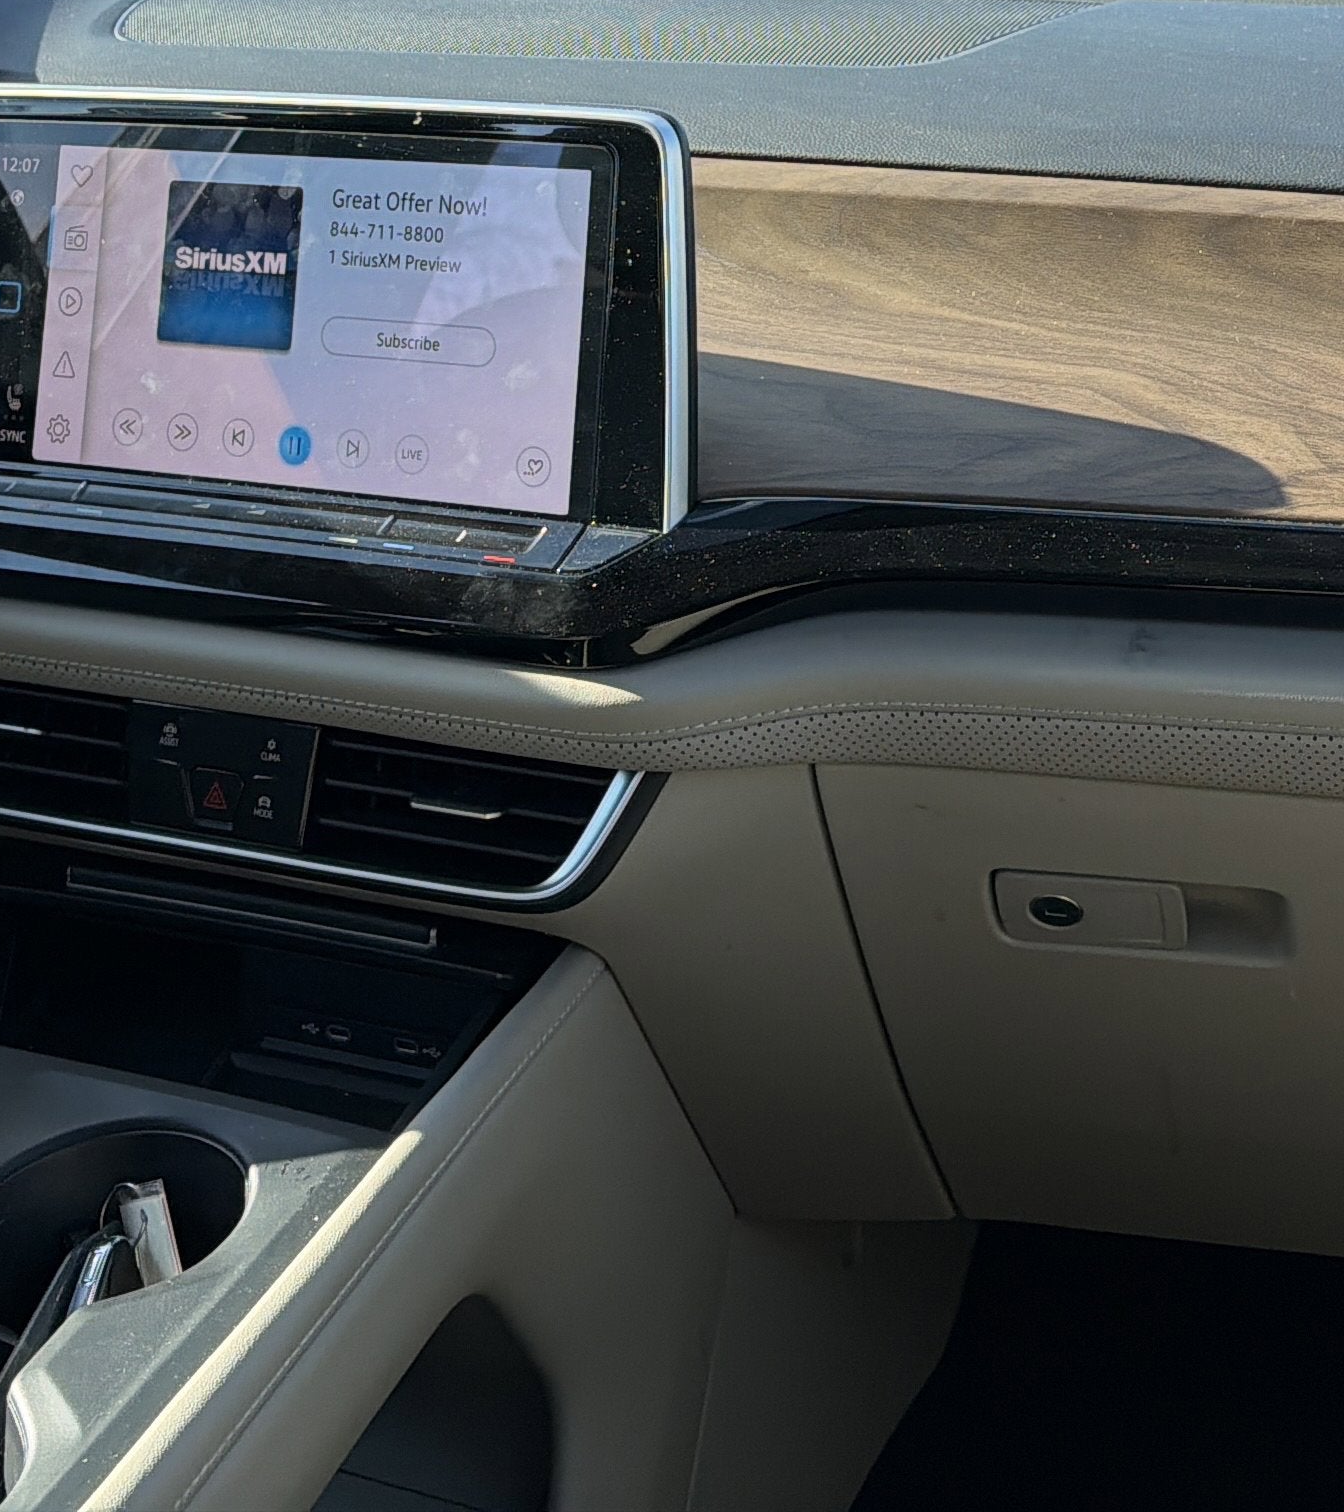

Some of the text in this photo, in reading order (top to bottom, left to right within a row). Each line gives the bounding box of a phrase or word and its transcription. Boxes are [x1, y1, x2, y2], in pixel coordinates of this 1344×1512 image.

[1, 156, 40, 174] 12:07
[332, 188, 488, 217] Great Offer Now!
[329, 220, 444, 243] 844-711-8800
[174, 246, 288, 276] SiriusXM
[328, 249, 462, 273] 1 SiriusXM Preview
[376, 332, 441, 352] Subscribe
[0, 428, 27, 444] SYNC
[401, 448, 423, 462] LIVE
[260, 751, 281, 763] CLIMA
[253, 807, 274, 820] MODE
